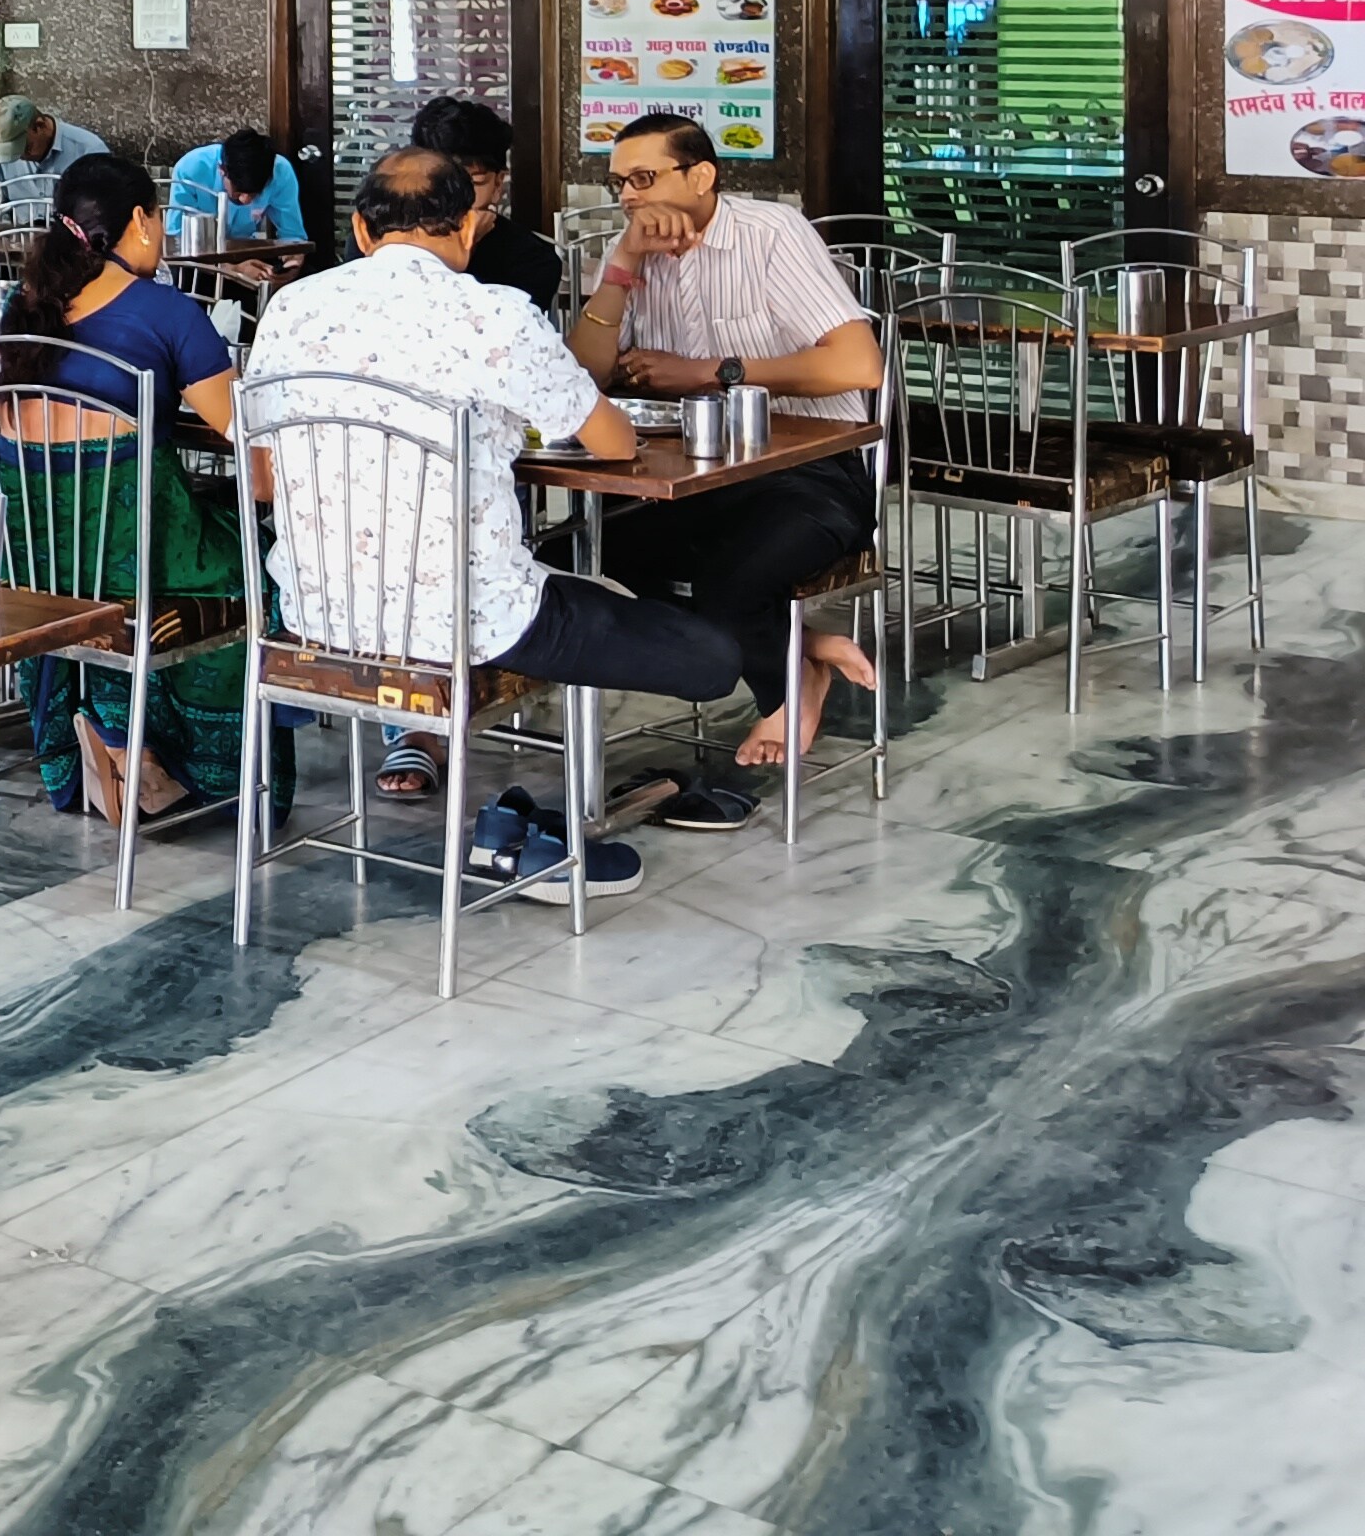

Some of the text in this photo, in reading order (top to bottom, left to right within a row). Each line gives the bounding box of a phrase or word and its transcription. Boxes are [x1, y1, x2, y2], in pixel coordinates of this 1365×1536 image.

[676, 40, 706, 52] पराठा
[607, 101, 638, 115] भाजी
[1227, 90, 1285, 117] रामदेव
